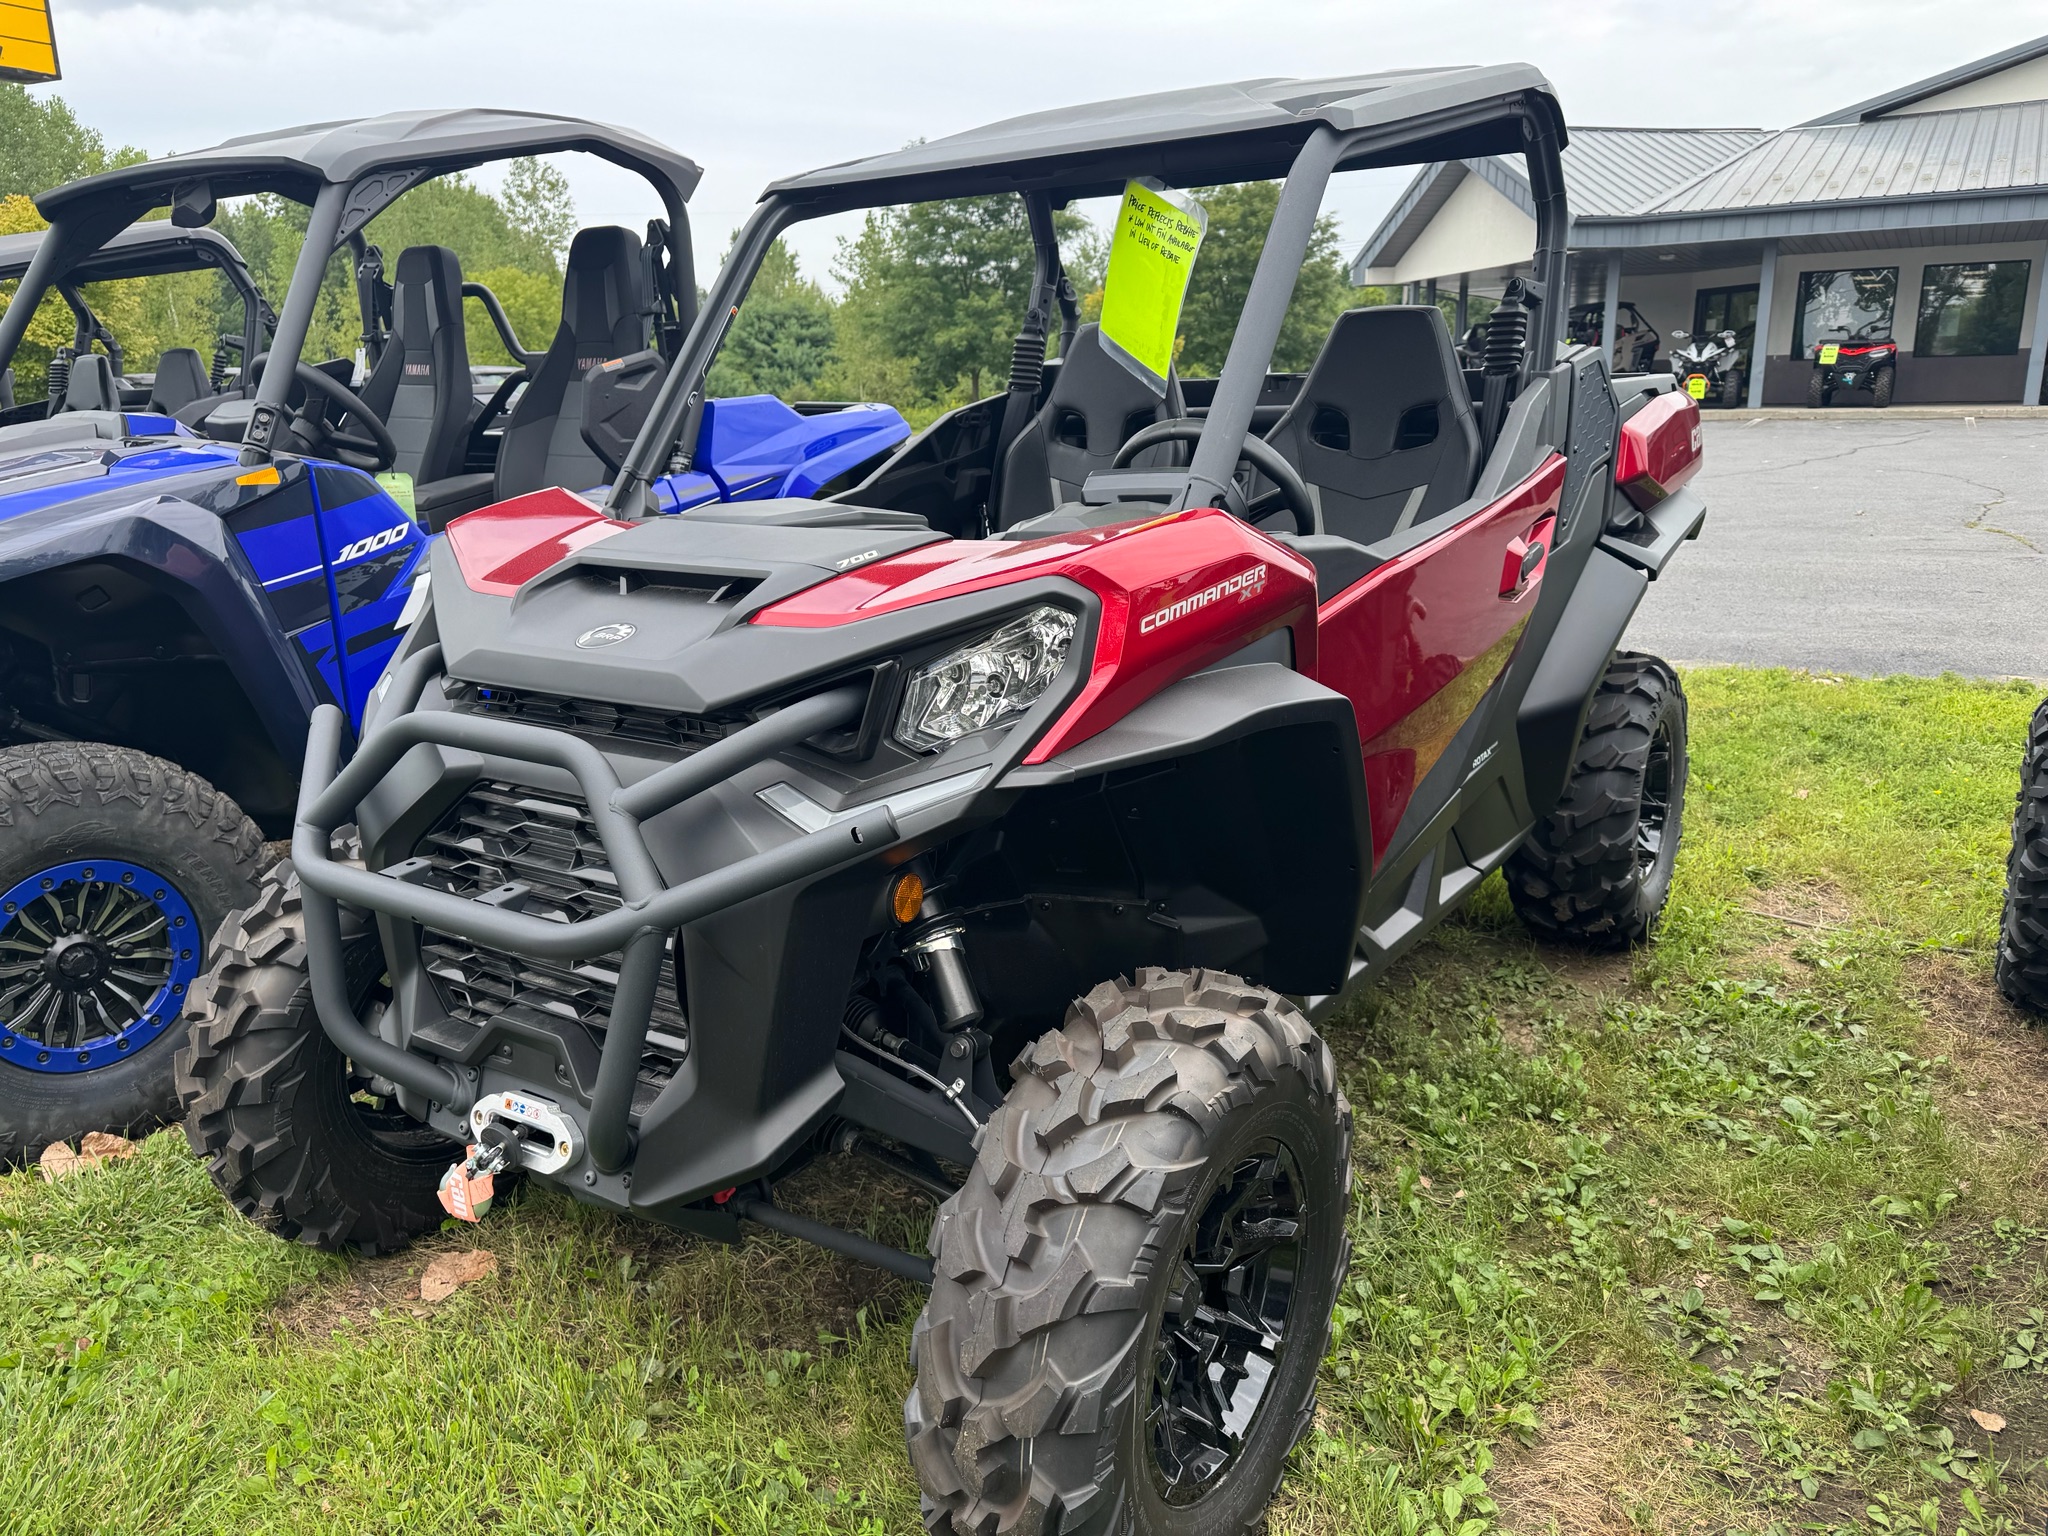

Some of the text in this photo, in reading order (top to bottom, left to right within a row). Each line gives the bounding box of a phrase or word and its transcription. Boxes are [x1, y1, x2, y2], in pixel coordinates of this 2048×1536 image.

[1147, 206, 1174, 229] REFLECTS
[1175, 219, 1198, 238] REBATE
[1160, 246, 1180, 264] REBATE
[405, 363, 430, 376] YAMAHA
[331, 521, 409, 565] 1000
[836, 550, 878, 569] 700
[1140, 563, 1267, 634] COMMANDER
[1239, 580, 1265, 601] XT
[1472, 741, 1498, 769] ROTAX
